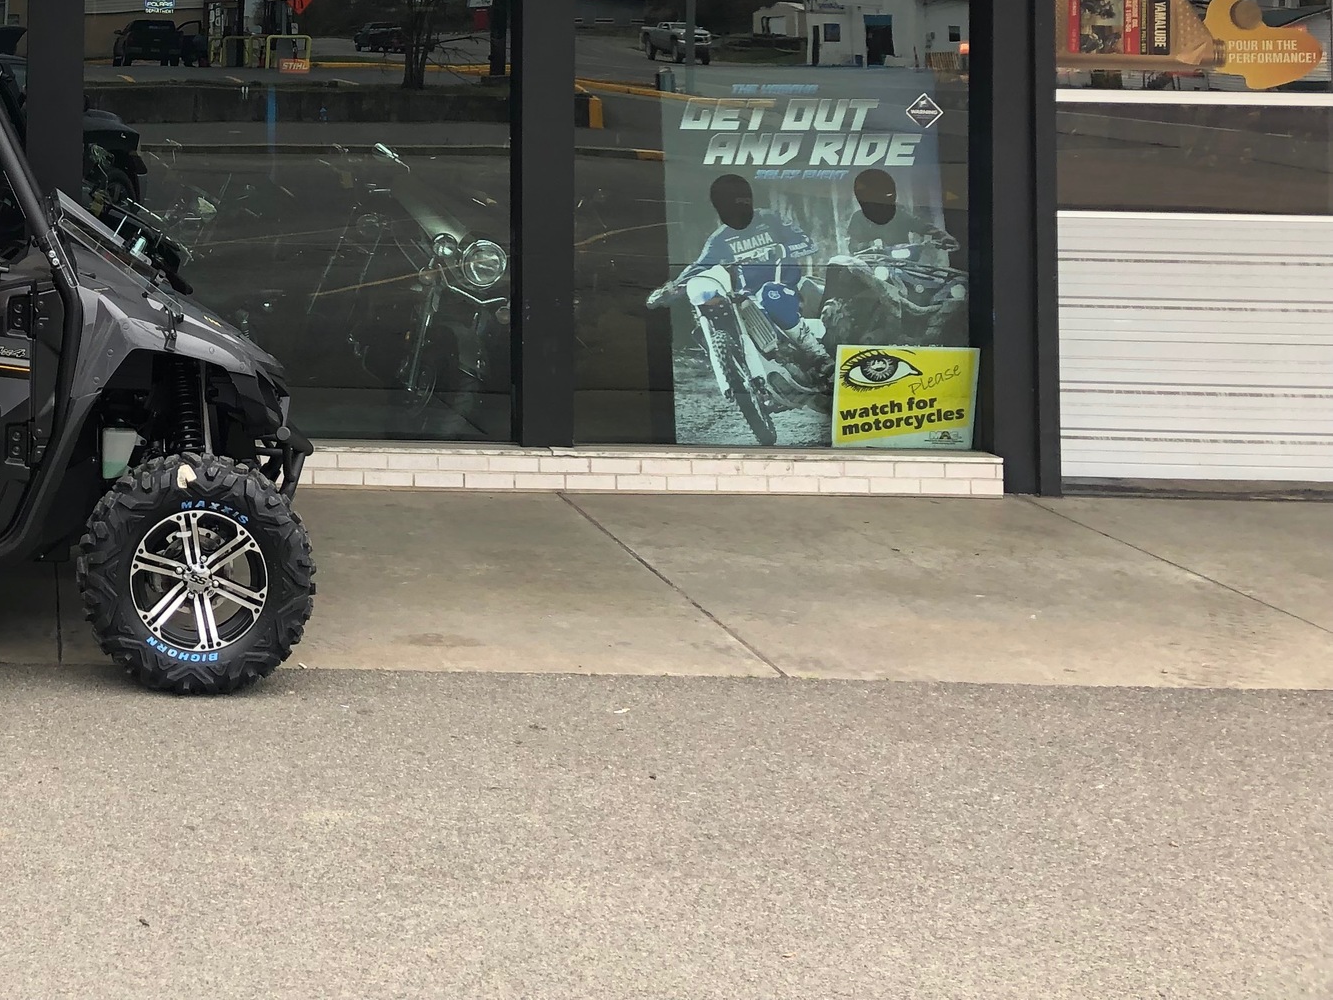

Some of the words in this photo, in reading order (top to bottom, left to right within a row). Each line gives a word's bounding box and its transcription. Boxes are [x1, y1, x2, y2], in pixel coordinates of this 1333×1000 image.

[1154, 0, 1167, 48] YAMALUBE
[1228, 39, 1259, 51] POUR
[1261, 40, 1273, 51] IN
[1277, 39, 1298, 51] THE
[1228, 52, 1317, 64] PERFORMANCE!
[282, 62, 309, 70] STIHL
[679, 98, 777, 131] GET
[779, 98, 880, 131] OUT
[703, 132, 804, 165] AND
[808, 133, 923, 166] RIDE
[729, 232, 773, 254] YAMAHA
[839, 400, 903, 421] watch
[906, 396, 938, 412] for
[841, 408, 965, 436] motorcycles
[180, 499, 249, 526] MAXXIS
[145, 635, 219, 663] BIGHORN
